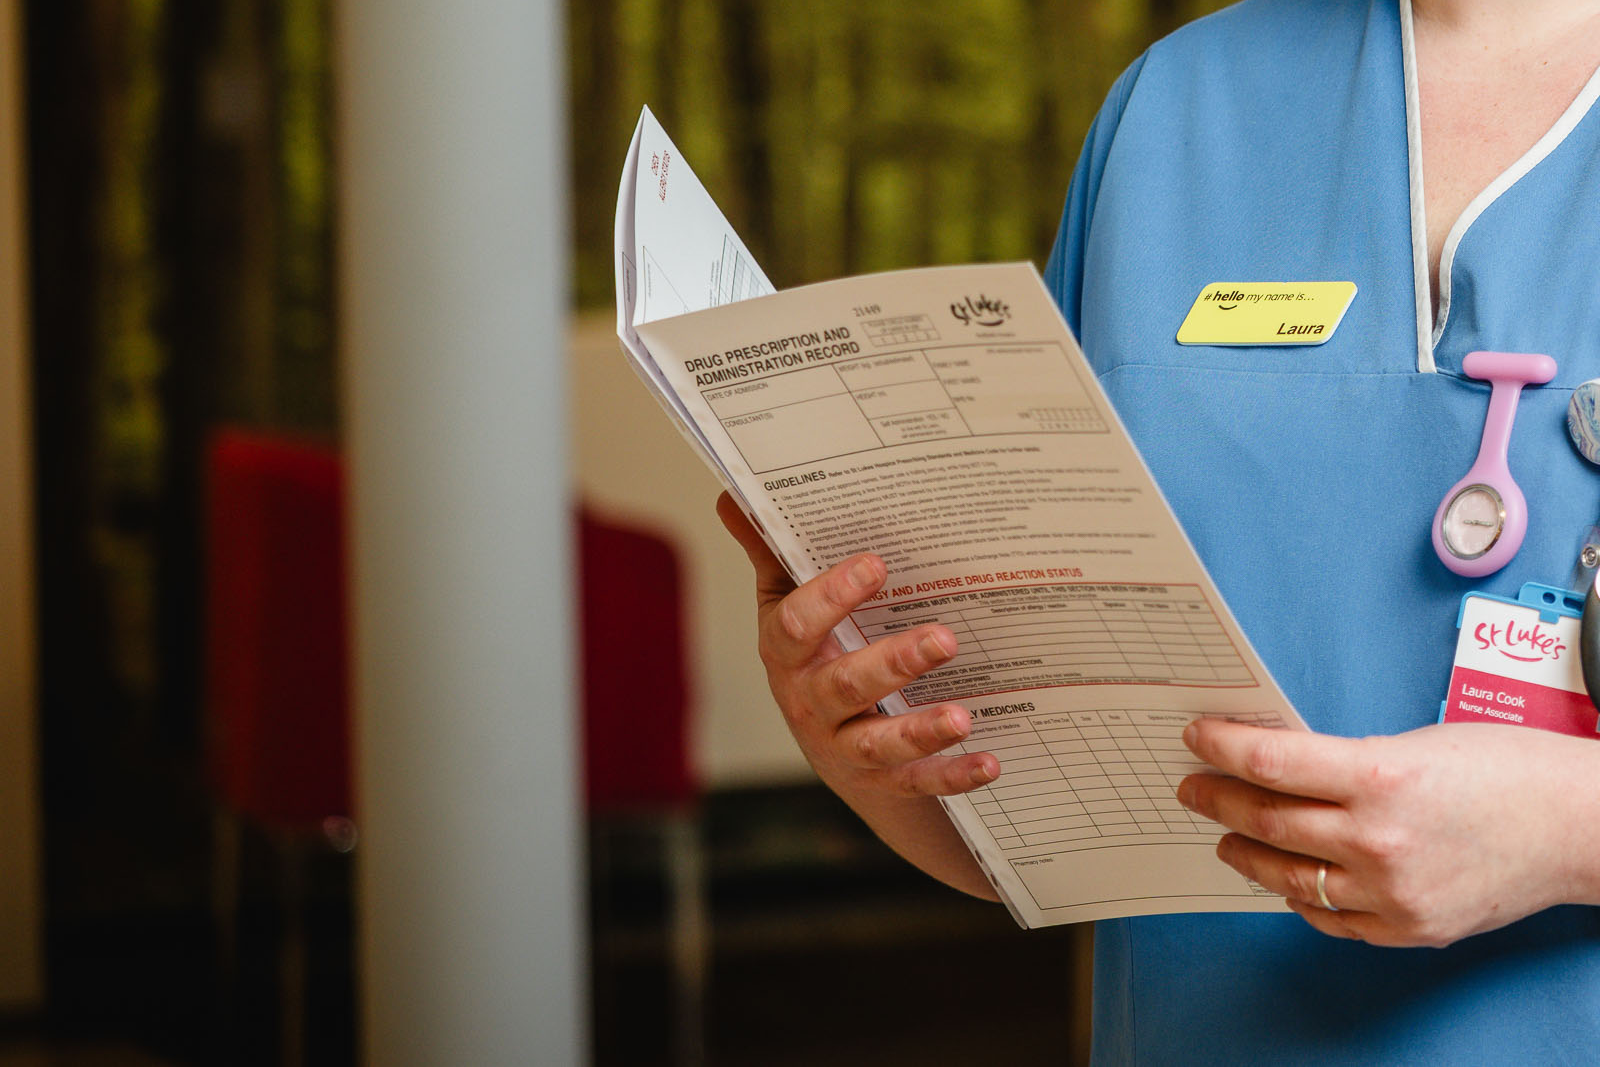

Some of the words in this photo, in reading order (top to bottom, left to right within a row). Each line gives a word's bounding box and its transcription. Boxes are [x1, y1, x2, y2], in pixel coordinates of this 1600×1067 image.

[1204, 293, 1211, 301] #
[1212, 291, 1244, 301] hello
[1245, 294, 1262, 304] my
[1264, 293, 1294, 301] name
[1276, 322, 1325, 335] Laura
[685, 353, 723, 373] DRUG
[725, 333, 820, 363] PRESCRIPTION
[824, 326, 851, 342] AND
[695, 352, 803, 387] ADMINISTRATION
[805, 341, 860, 362] RECORD
[707, 390, 724, 402] DATE
[725, 389, 734, 398] OF
[735, 382, 769, 396] ADMISSION
[764, 470, 827, 491] GUIDELINES
[828, 469, 844, 478] Refer
[892, 585, 913, 598] AND
[916, 578, 963, 593] ADVERSE
[965, 572, 994, 586] DRUG
[996, 568, 1046, 582] REACTION
[1047, 568, 1083, 579] STATUS
[932, 599, 951, 608] MUST
[952, 596, 968, 604] NOT
[980, 588, 1031, 600] ADMINISTERED
[1474, 622, 1502, 650] St
[1505, 620, 1567, 660] Luke's
[929, 668, 959, 680] ALLERGIES
[969, 664, 995, 674] ADVERSE
[995, 662, 1012, 670] DRUG
[1012, 659, 1043, 669] REACTIONS
[903, 683, 928, 694] ALLERGY
[930, 680, 950, 690] STATUS
[951, 675, 992, 687] UNCONFIRMED
[1462, 683, 1494, 701] Laura
[1496, 691, 1526, 708] Cook
[982, 702, 1036, 719] MEDICINES
[1459, 700, 1483, 714] Nurse
[1484, 707, 1524, 723] Associate
[1013, 858, 1039, 868] Pharmacy
